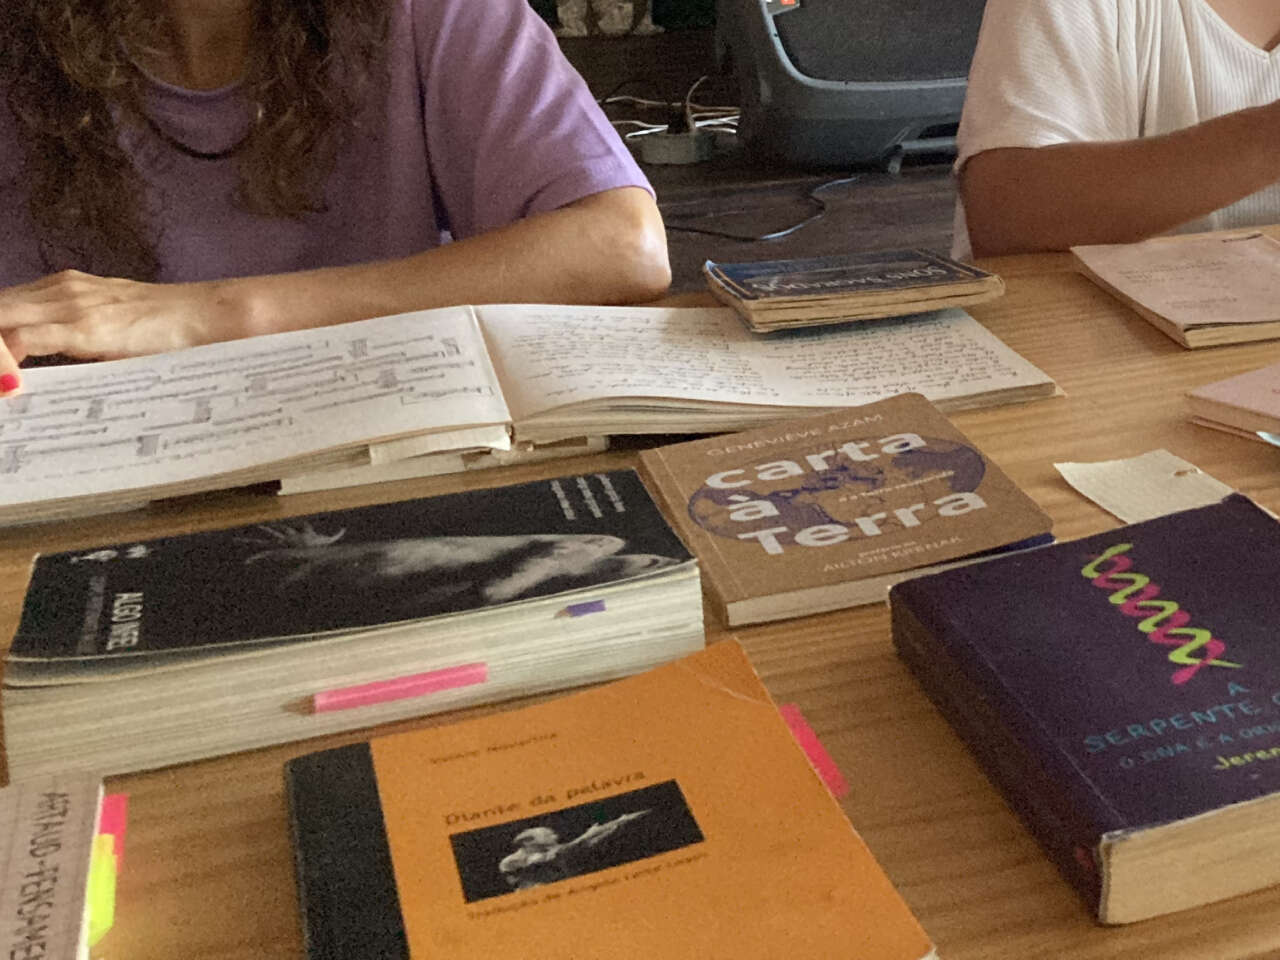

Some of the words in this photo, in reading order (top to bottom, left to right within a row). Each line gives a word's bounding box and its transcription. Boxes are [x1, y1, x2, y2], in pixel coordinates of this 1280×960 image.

[705, 432, 928, 490] carta
[728, 494, 781, 523] à
[738, 491, 988, 556] Terra
[111, 592, 144, 622] ALGO
[1228, 681, 1250, 697] A
[1084, 700, 1264, 753] SERPENTE
[444, 801, 521, 826] Diante
[529, 793, 558, 808] da
[566, 770, 646, 801] palavra
